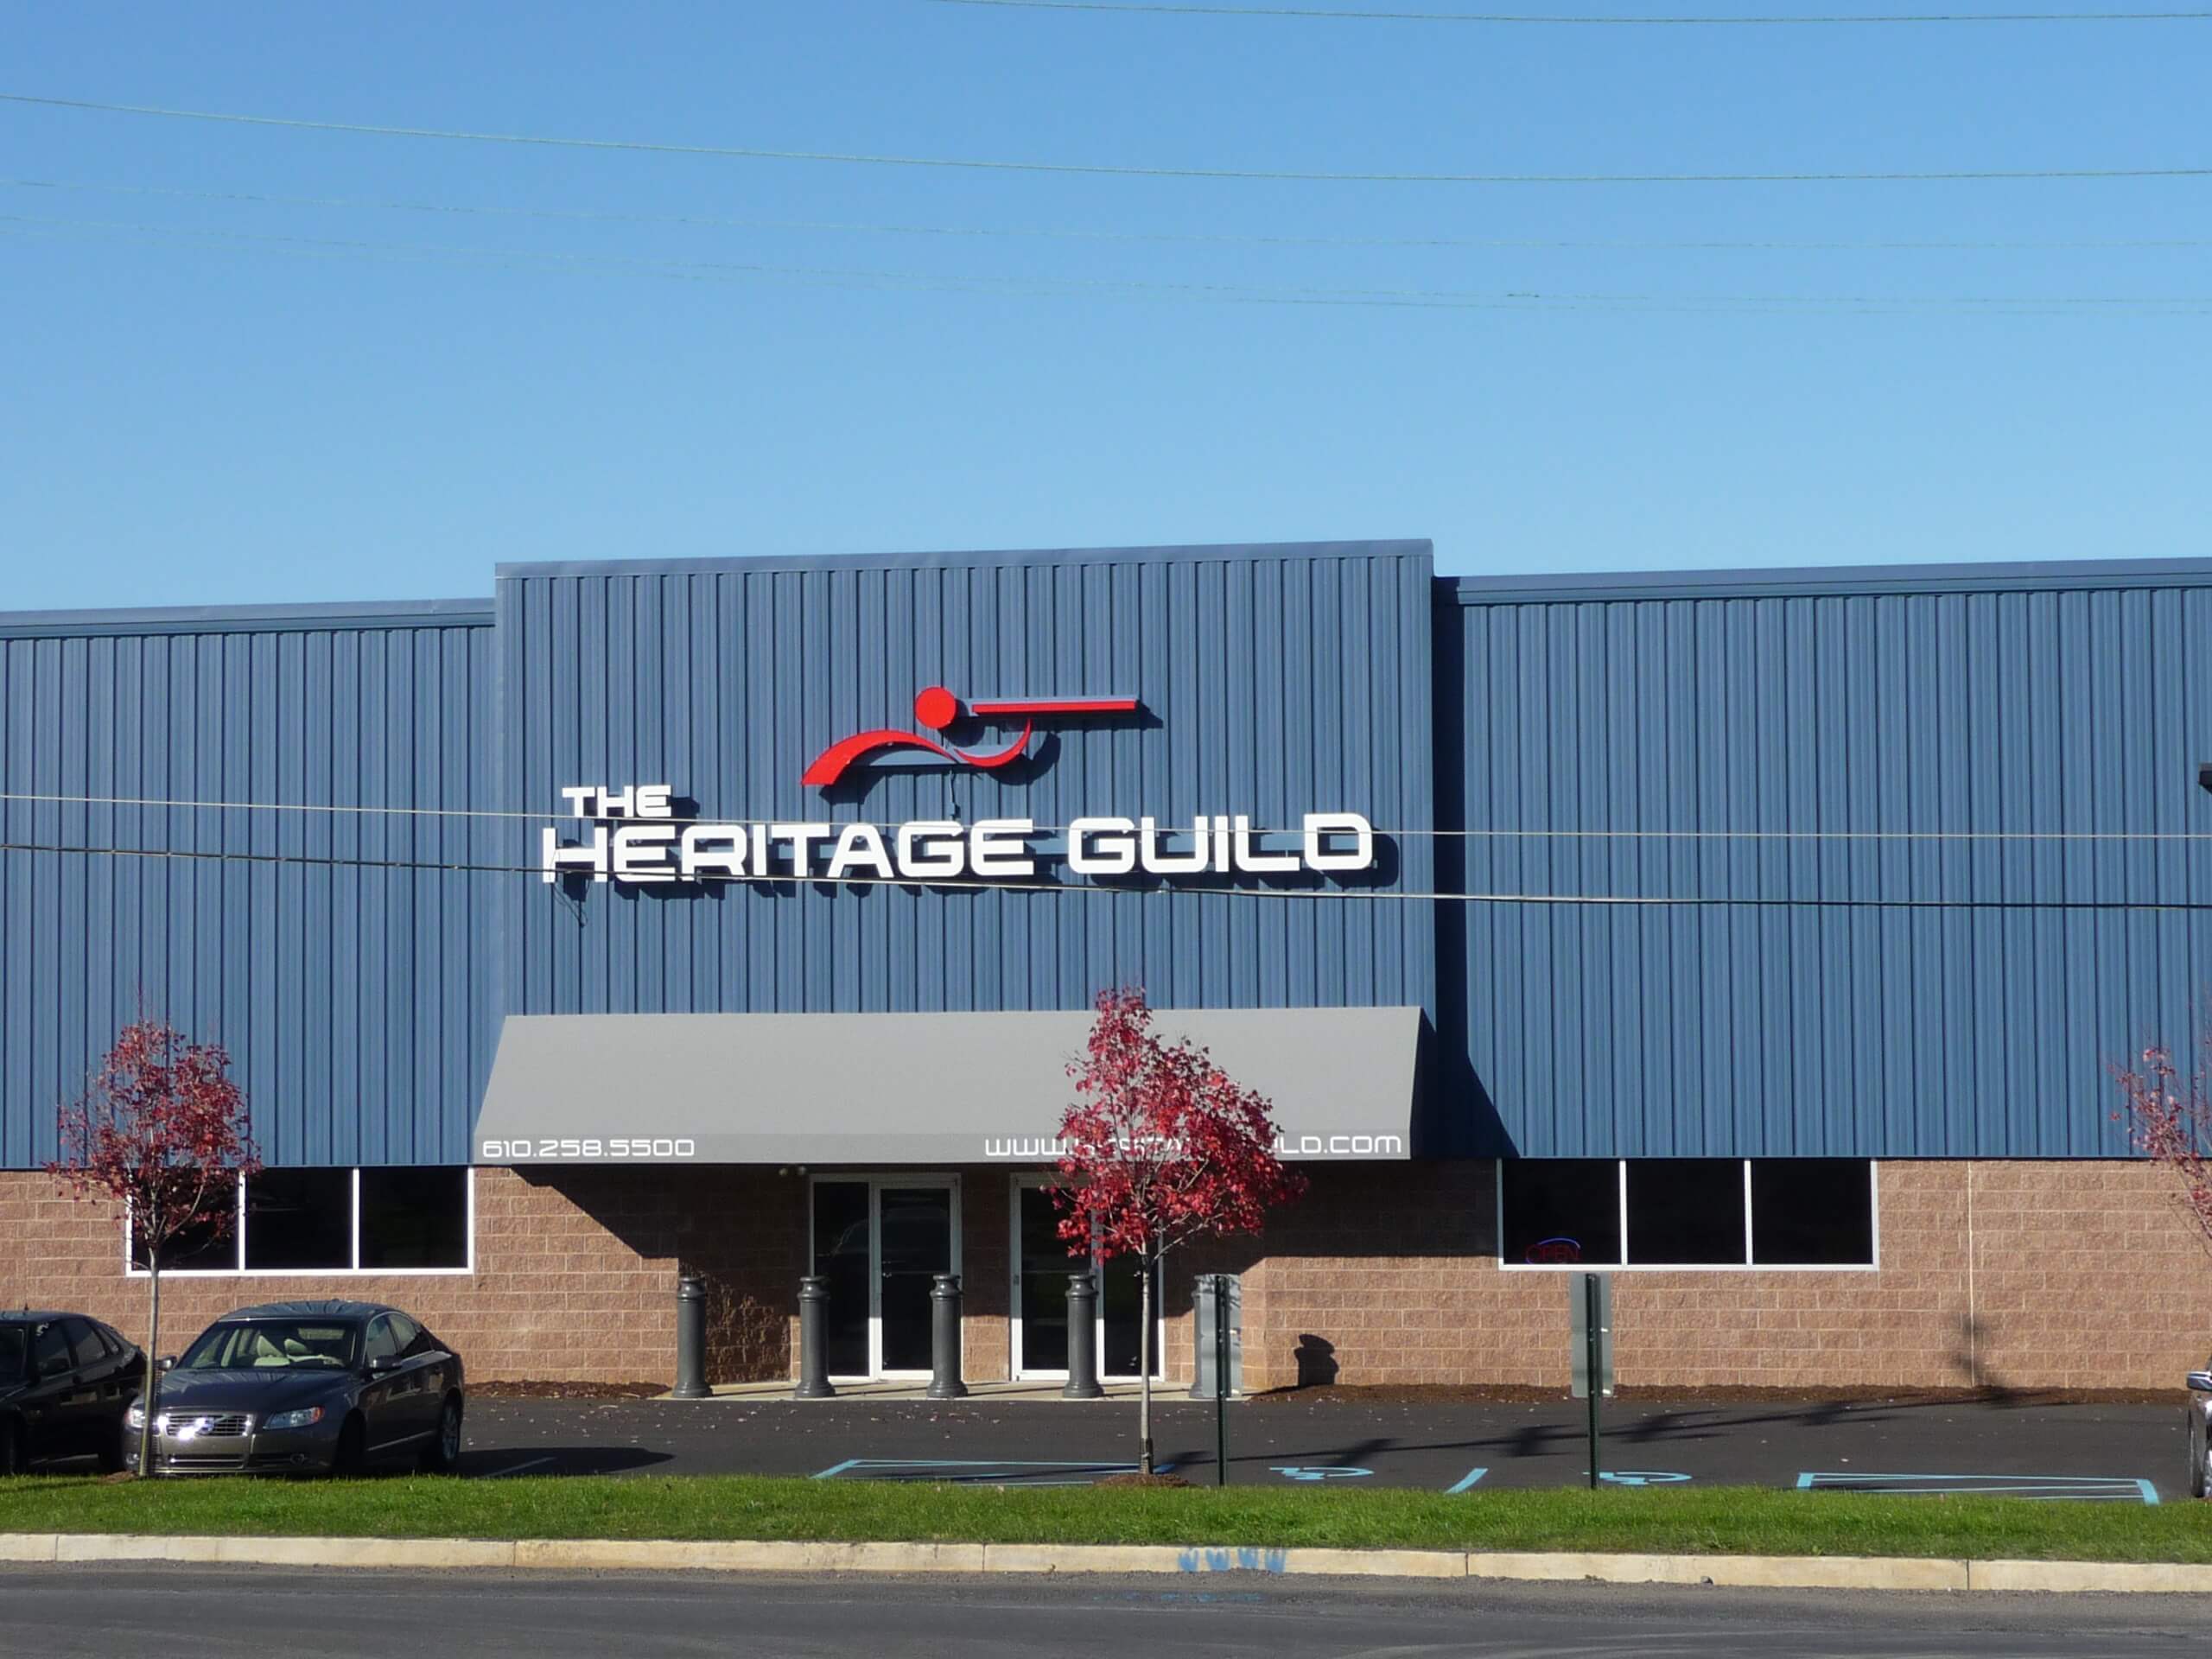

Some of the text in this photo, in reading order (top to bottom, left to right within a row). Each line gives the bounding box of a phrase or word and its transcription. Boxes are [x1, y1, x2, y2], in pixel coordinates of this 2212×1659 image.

[563, 785, 671, 817] THE
[543, 813, 1372, 882] HERITAGE GUILD
[482, 1140, 695, 1157] 610.258.5500
[1526, 1244, 1580, 1262] OPEN
